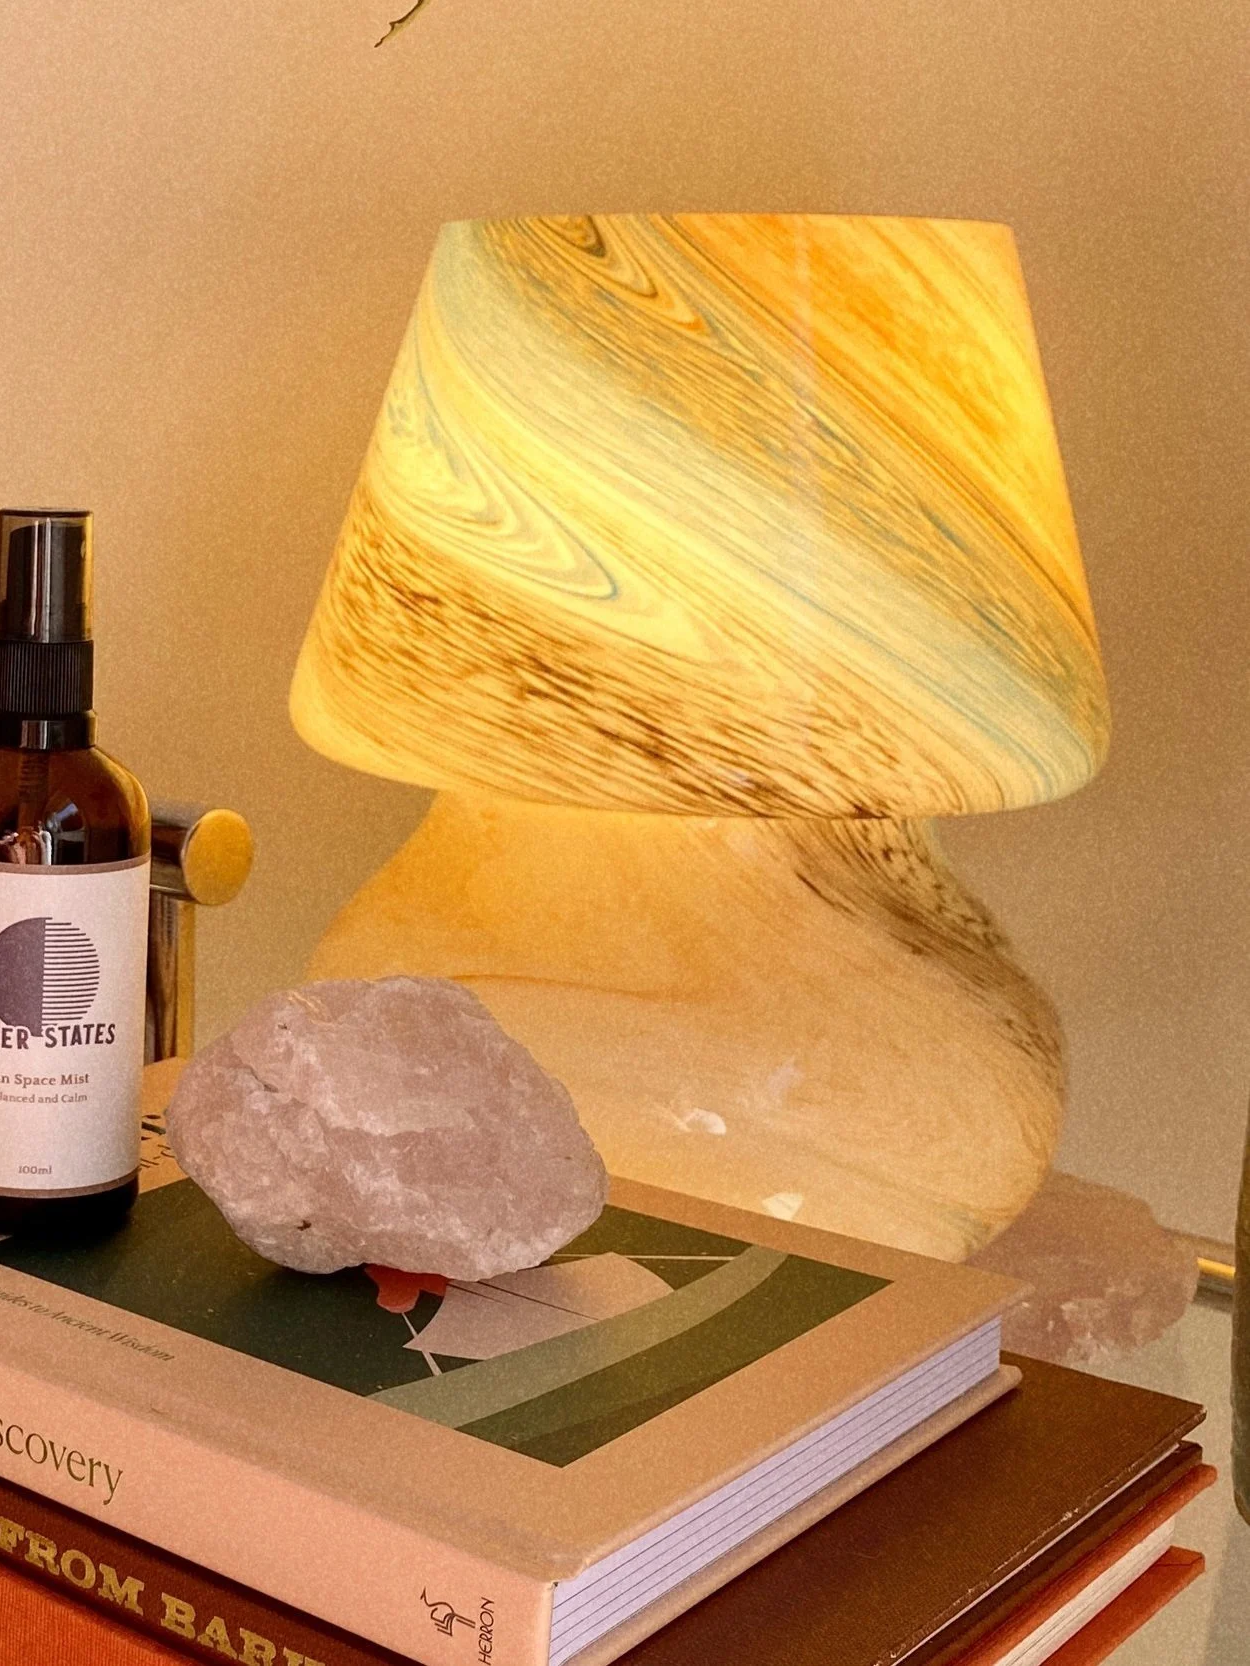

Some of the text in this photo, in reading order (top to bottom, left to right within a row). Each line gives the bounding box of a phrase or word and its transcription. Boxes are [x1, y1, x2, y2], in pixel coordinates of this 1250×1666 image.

[44, 1022, 116, 1049] STATES
[14, 1073, 57, 1089] Space
[60, 1072, 90, 1086] Mist
[37, 1092, 59, 1104] and
[60, 1092, 88, 1104] Calm
[17, 1165, 53, 1176] 100ml
[47, 1311, 110, 1338] Ancient
[108, 1331, 176, 1363] Wisdom
[477, 1596, 496, 1666] HERRON
